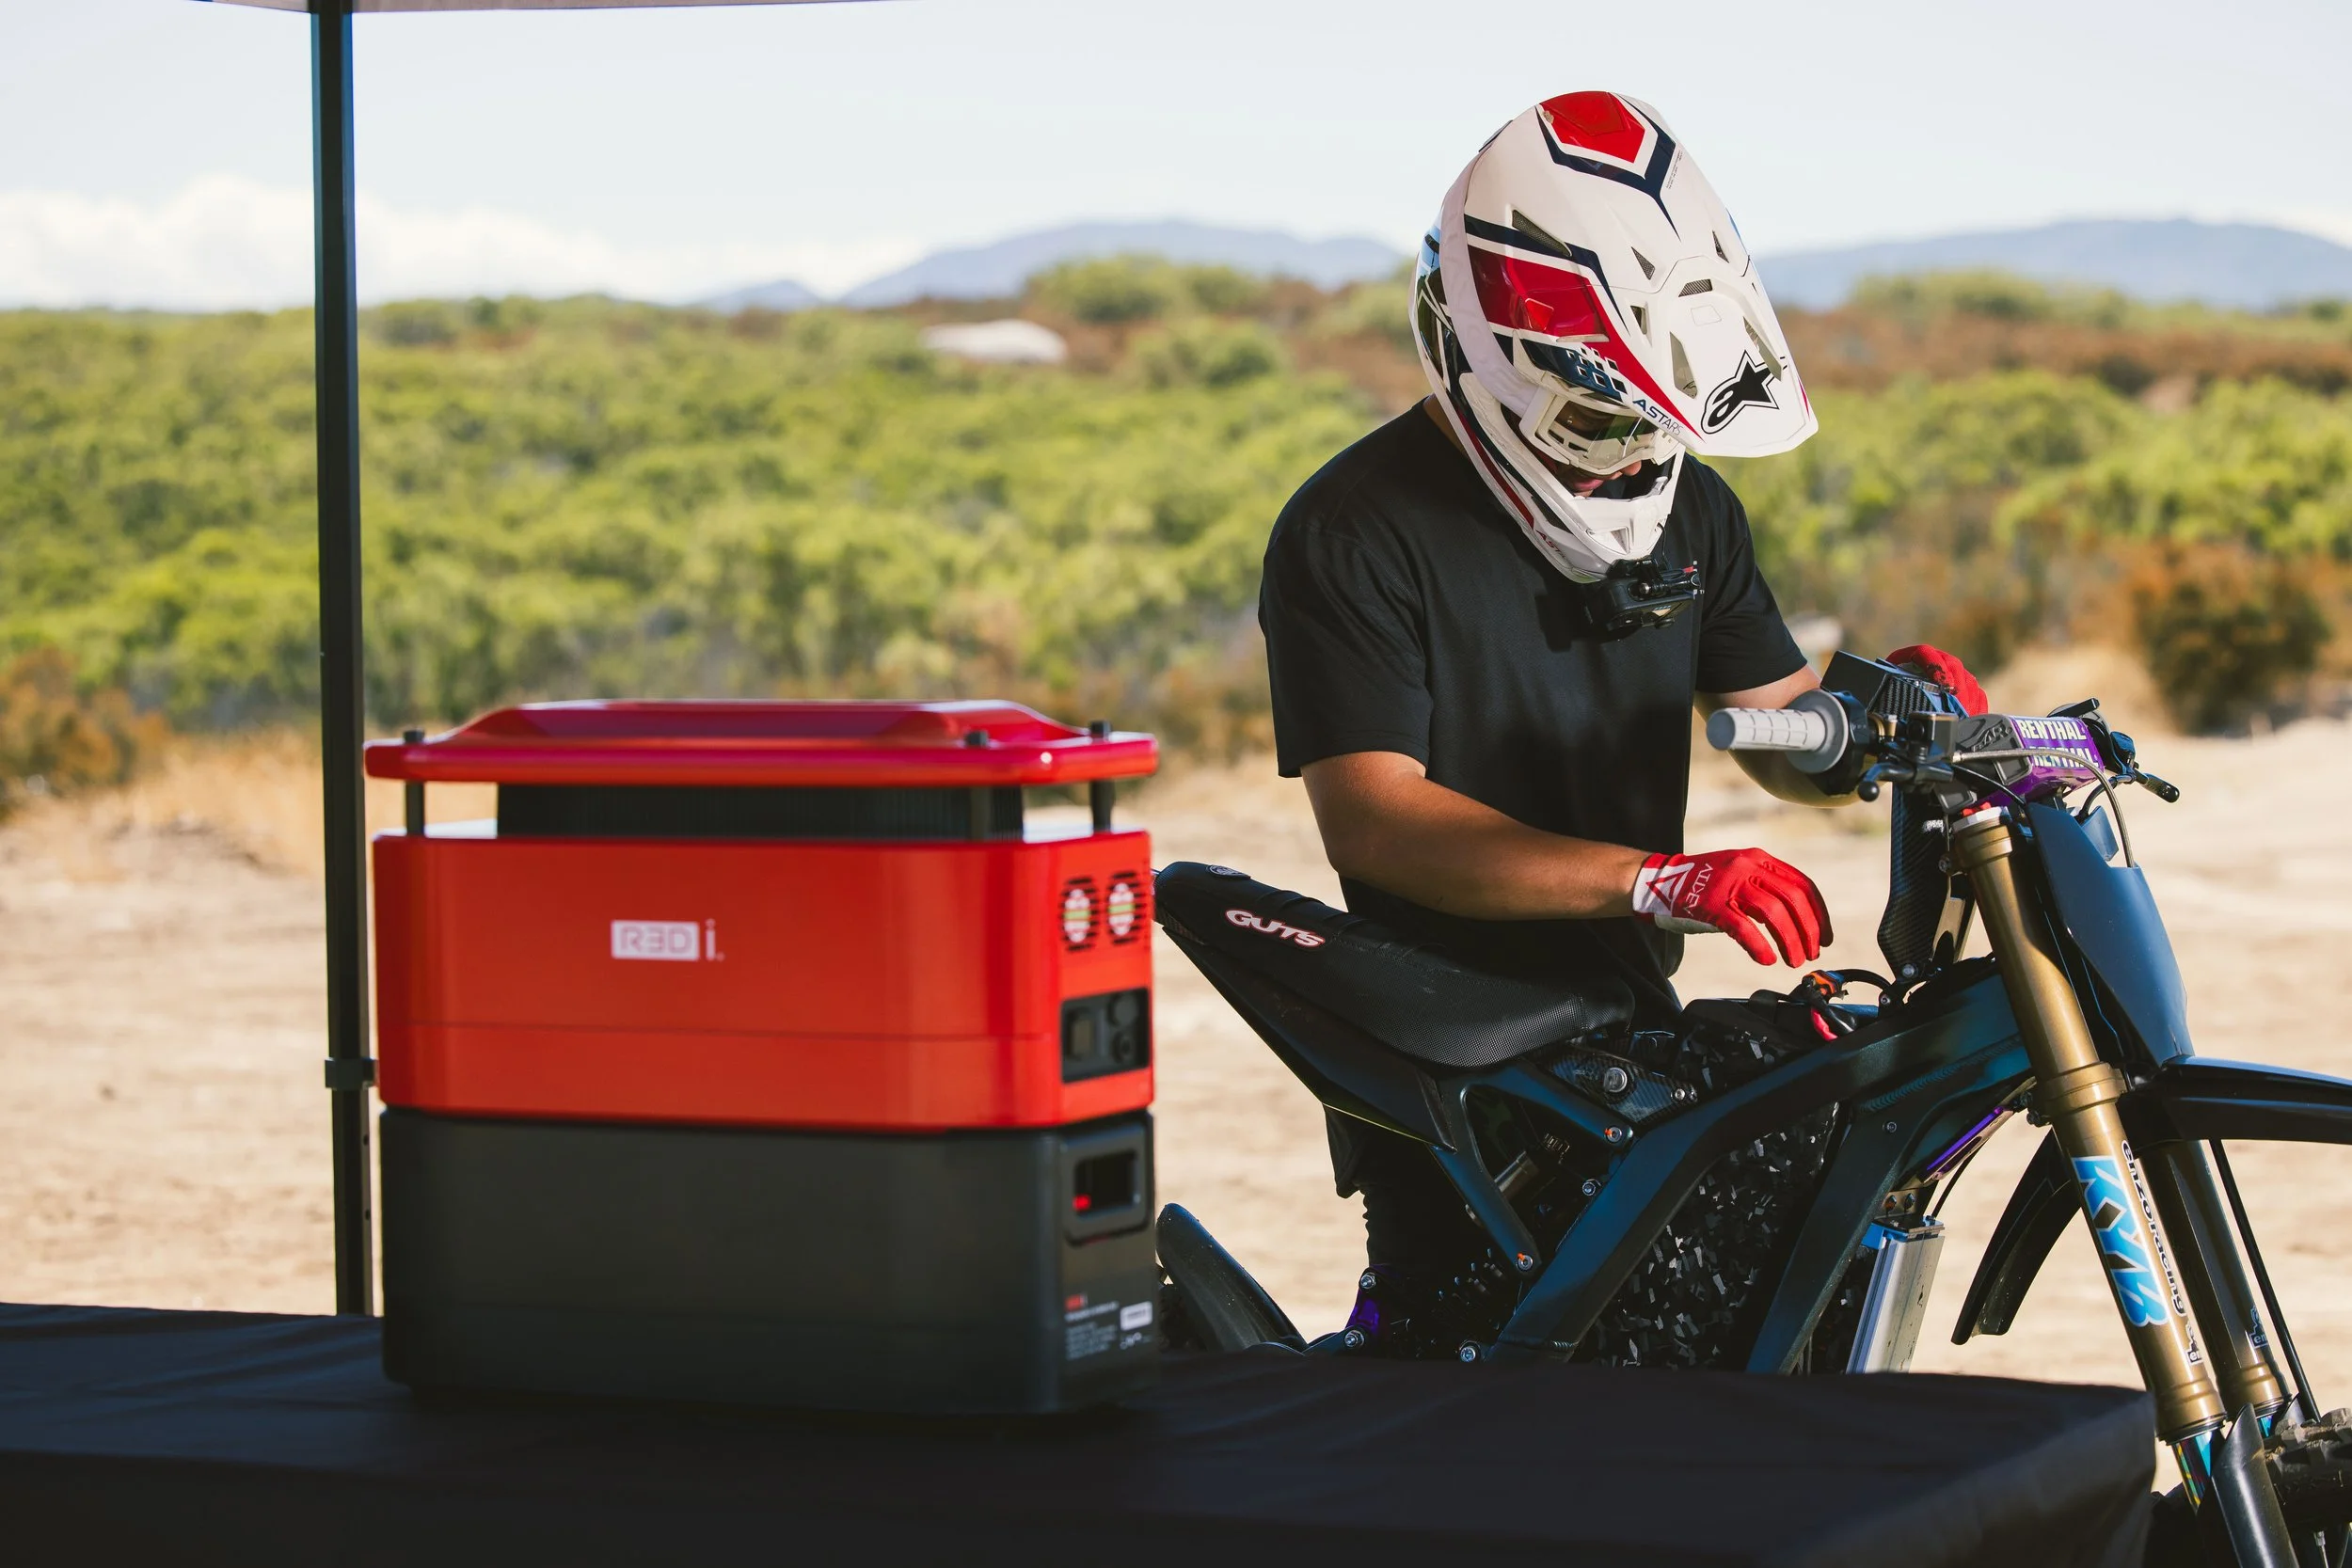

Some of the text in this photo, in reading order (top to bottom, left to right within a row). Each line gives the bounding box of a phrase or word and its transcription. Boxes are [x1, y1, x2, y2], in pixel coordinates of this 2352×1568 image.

[1632, 399, 1684, 435] ASTARS
[2016, 719, 2088, 740] RENTHAL
[1225, 908, 1326, 948] GUTS
[2071, 1155, 2169, 1327] KYB
